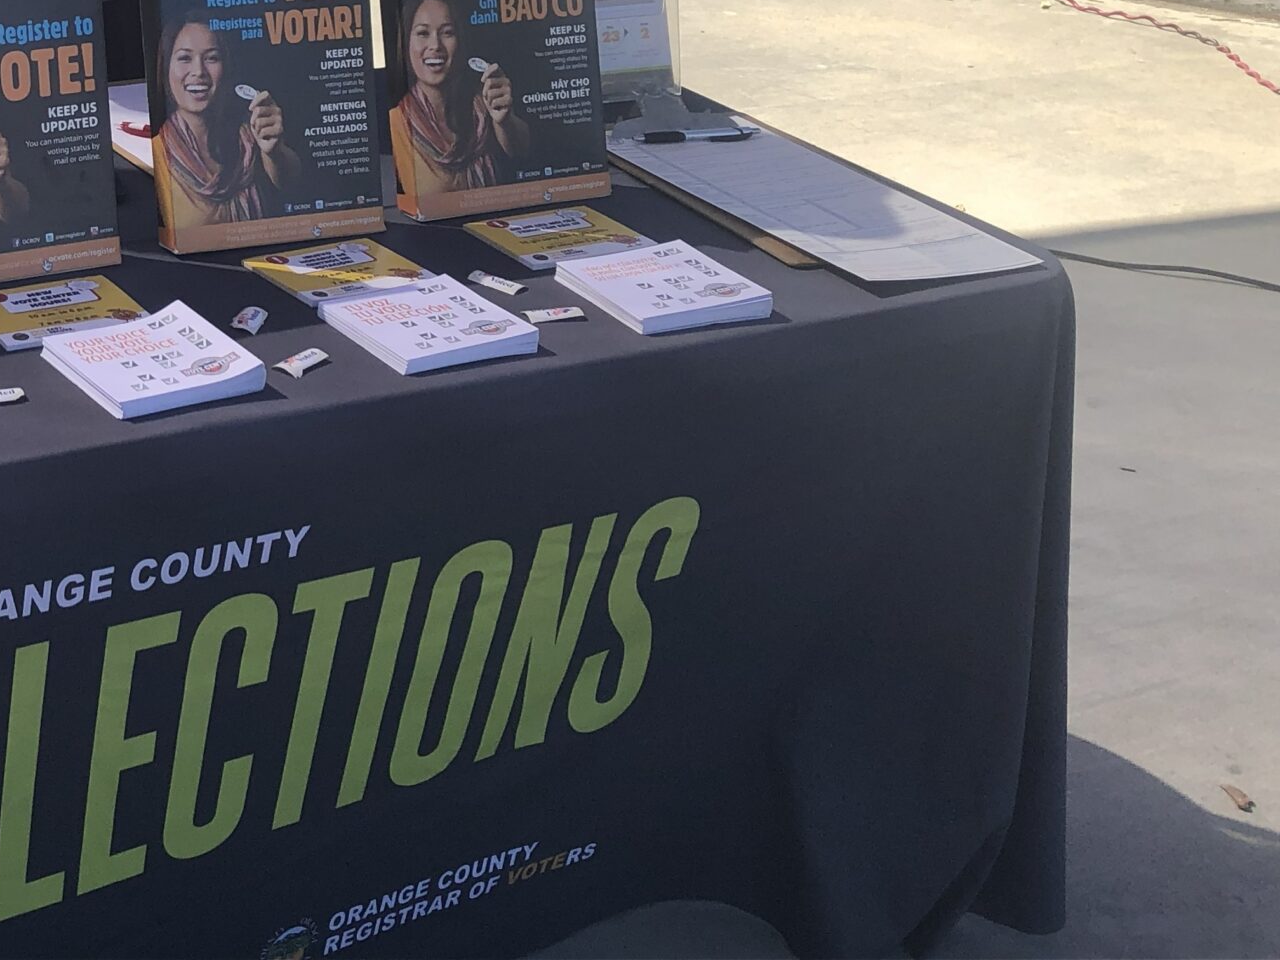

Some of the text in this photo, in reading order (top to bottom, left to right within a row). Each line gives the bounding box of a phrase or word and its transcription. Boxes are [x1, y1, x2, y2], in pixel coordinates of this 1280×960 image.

[265, 3, 364, 46] VOTAR!
[470, 9, 499, 26] danh
[74, 15, 95, 37] to
[549, 23, 587, 36] KEEP US
[241, 28, 264, 41] para
[544, 34, 588, 48] UPDATED
[325, 46, 364, 60] KEEP US
[320, 57, 365, 71] UPDATED
[47, 101, 99, 119] KEEP US
[320, 100, 367, 113] MENTENGA
[40, 116, 99, 134] UPDATED
[322, 111, 368, 124] SUS DATOS
[304, 122, 369, 138] ACTUALIZADOS
[39, 135, 84, 147] can maintain
[47, 142, 101, 156] voting status by
[362, 297, 396, 311] VOZ
[371, 302, 413, 318] VOTO
[384, 302, 455, 324] ELECCIÓN
[66, 328, 150, 351] YOUR VOICE
[72, 337, 151, 358] YOUR VOTE
[79, 338, 178, 365] YOUR CHOICE
[128, 524, 312, 594] COUNTY
[327, 840, 541, 933] ORANGE COUNTY
[321, 841, 598, 957] REGISTRAR OF VOTERS
